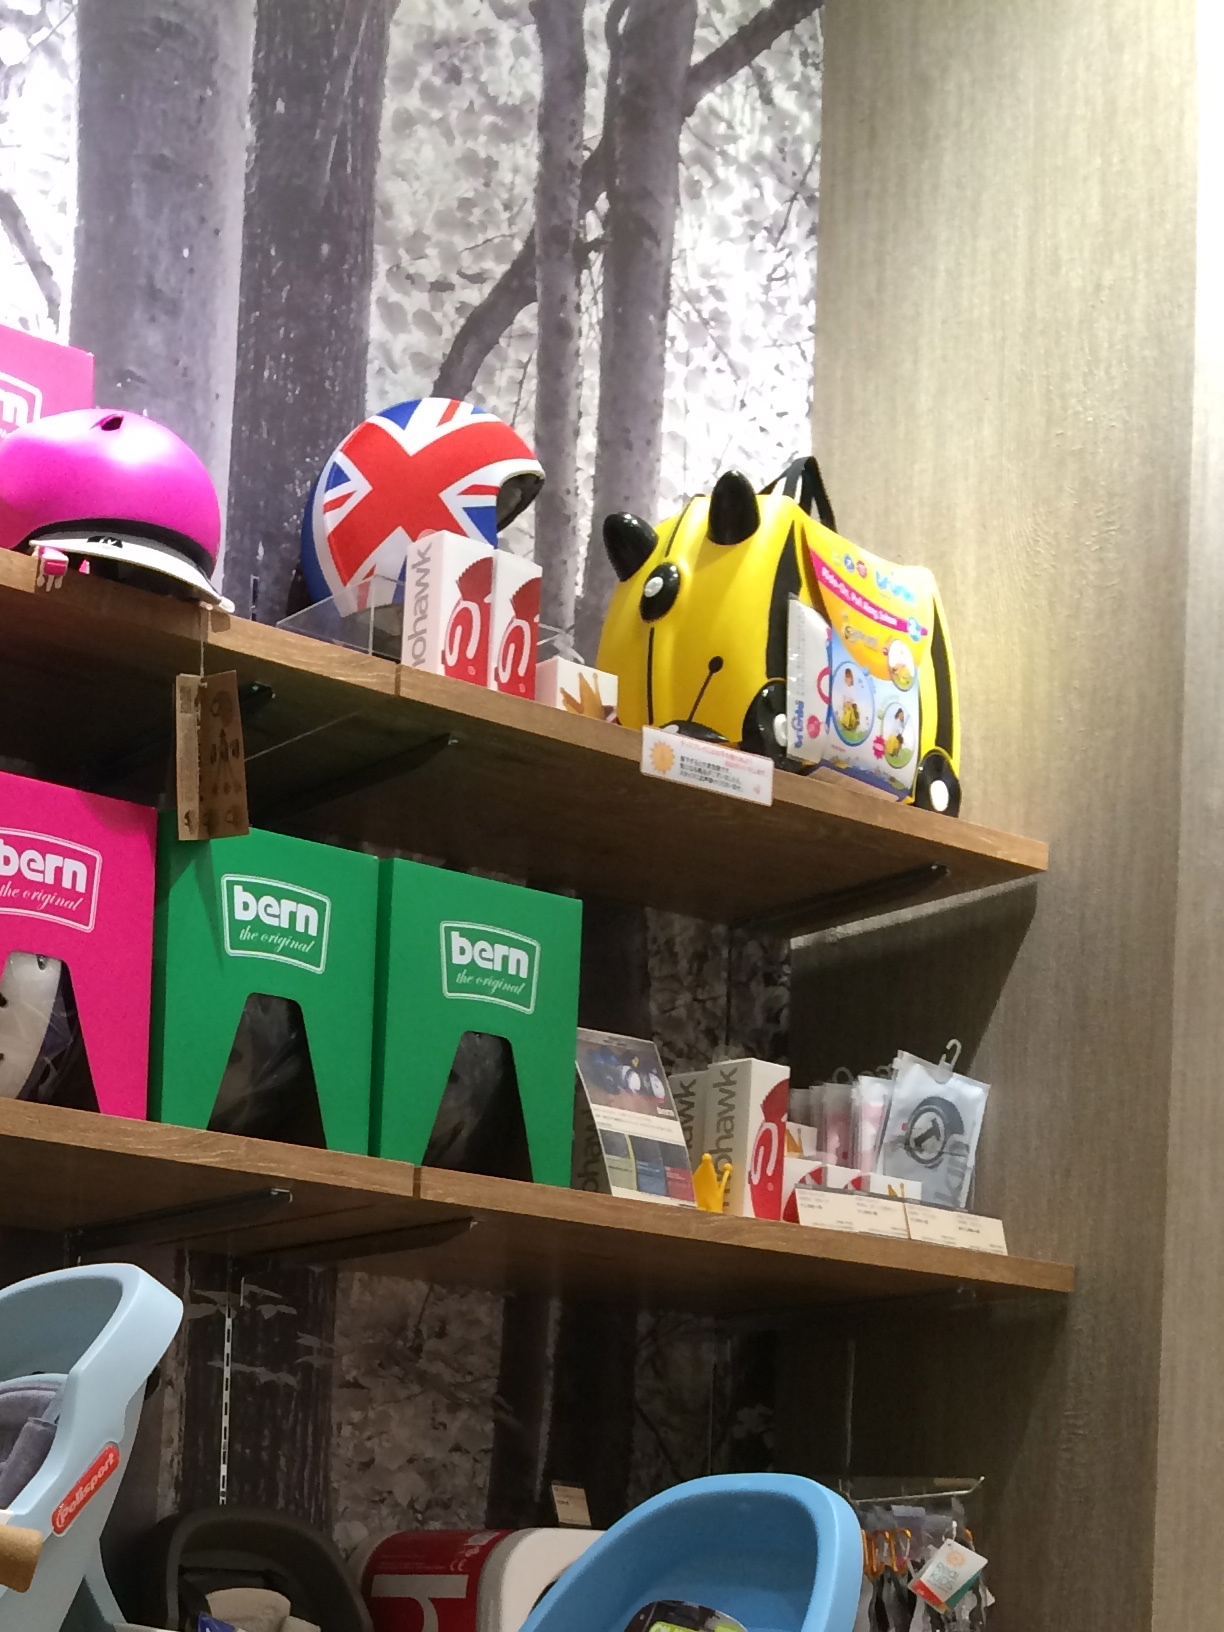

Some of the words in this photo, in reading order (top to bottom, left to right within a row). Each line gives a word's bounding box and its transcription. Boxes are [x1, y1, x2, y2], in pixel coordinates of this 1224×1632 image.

[0, 880, 20, 897] the
[22, 889, 84, 911] original
[233, 884, 319, 937] bern
[239, 925, 259, 941] the
[260, 933, 315, 953] original
[450, 931, 529, 979] bern
[455, 968, 474, 985] the
[475, 975, 526, 995] original
